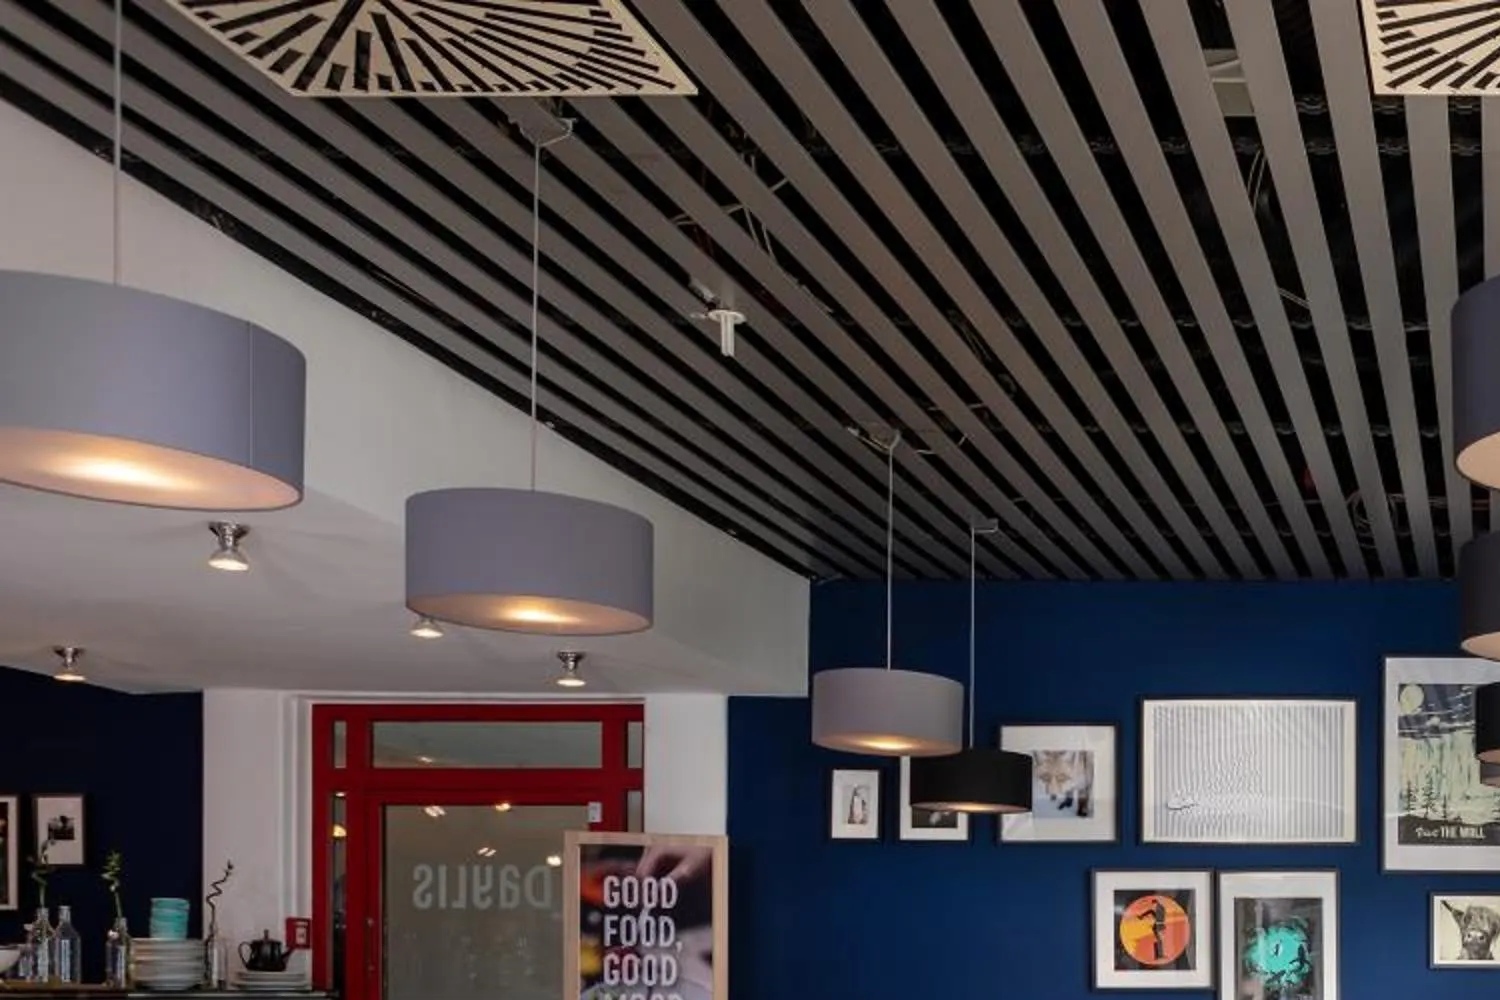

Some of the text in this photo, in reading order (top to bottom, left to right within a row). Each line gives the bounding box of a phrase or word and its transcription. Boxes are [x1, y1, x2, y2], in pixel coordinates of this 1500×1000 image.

[603, 875, 679, 909] GOOD
[603, 914, 683, 955] FOOD,
[603, 953, 678, 987] GOOD
